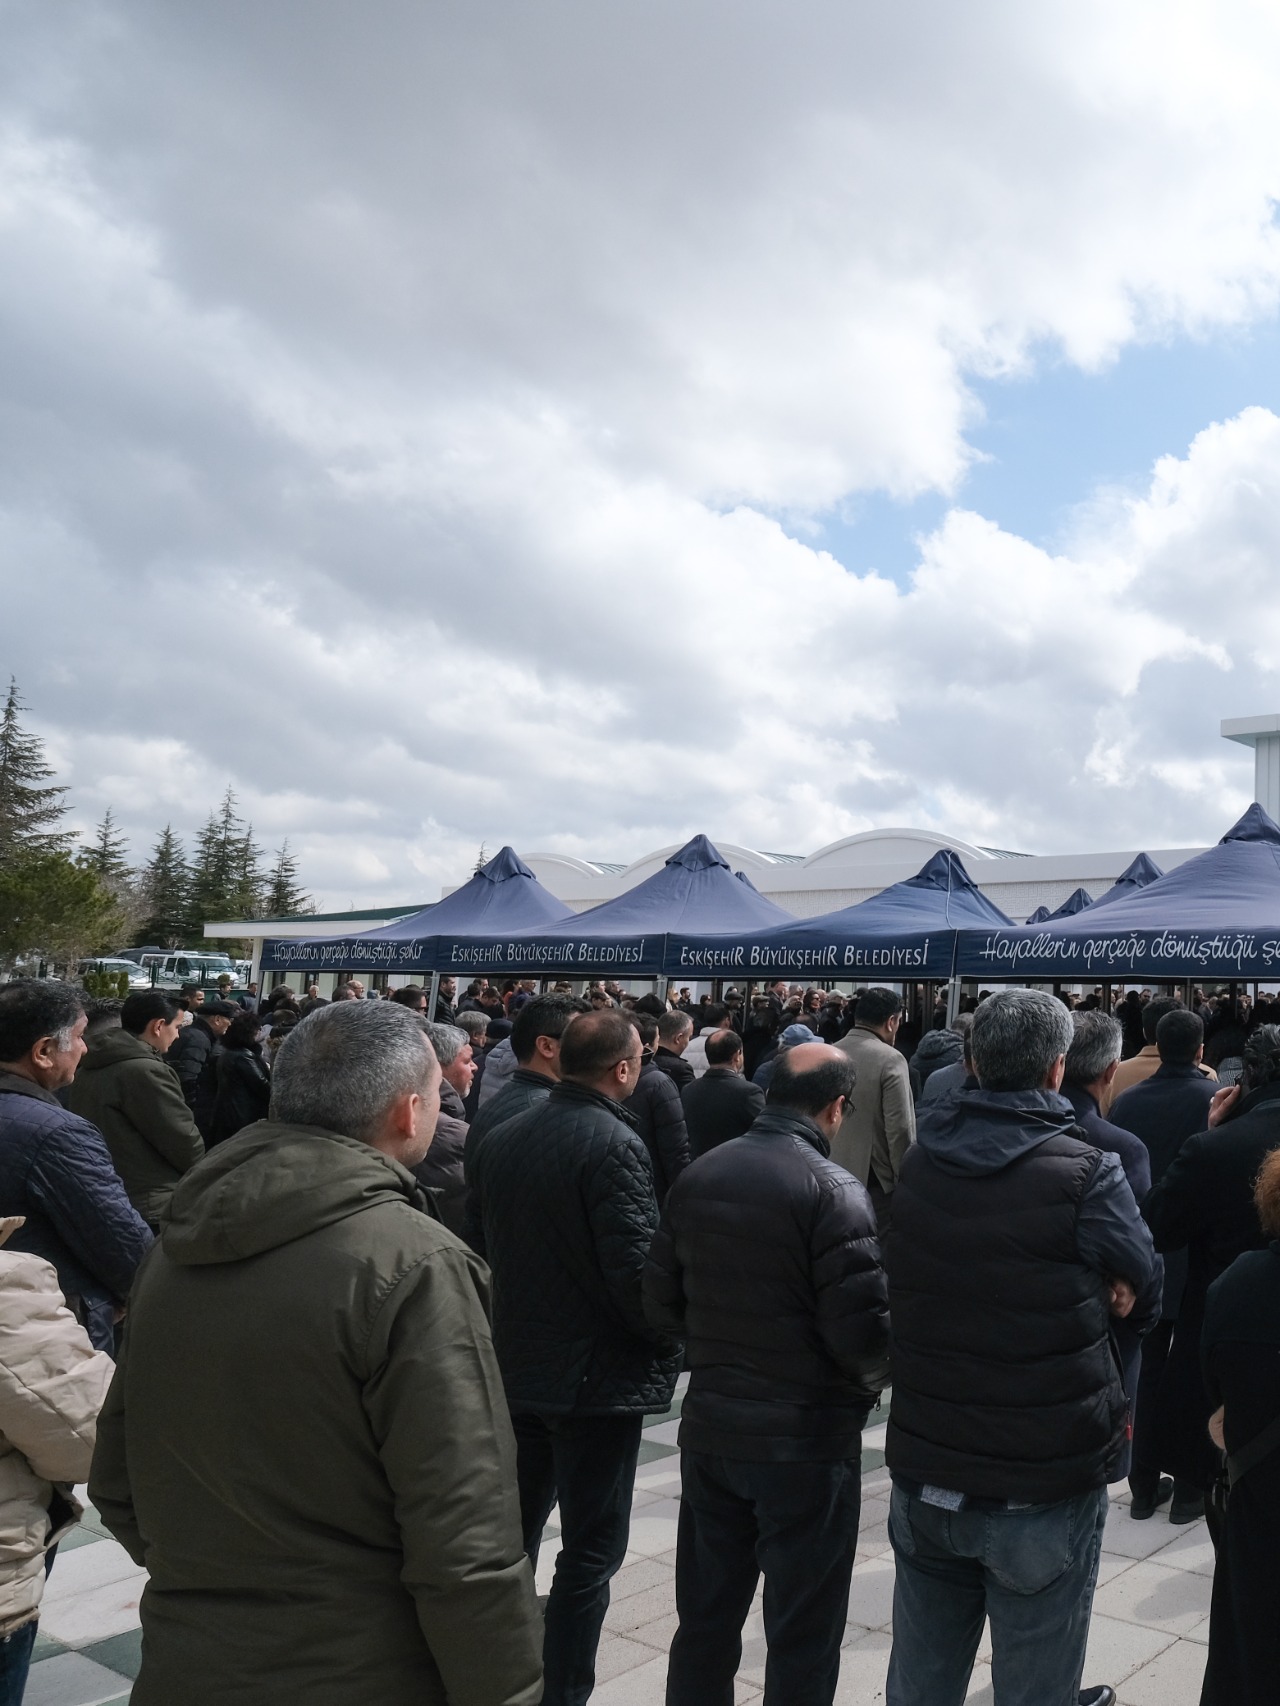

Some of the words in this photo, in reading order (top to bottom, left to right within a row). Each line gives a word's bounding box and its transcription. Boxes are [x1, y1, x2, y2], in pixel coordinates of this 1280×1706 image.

[272, 941, 318, 966] Hayallerin
[350, 939, 397, 966] dönüştüğü
[399, 939, 423, 963] şehir
[451, 944, 502, 965] ESKİŞEHİR
[507, 943, 574, 964] BÜYÜKŞEHİR
[578, 939, 645, 962] BELEDİYESİ
[680, 946, 745, 969] ESKİŞEHİR
[750, 945, 838, 969] BÜYÜKŞEHİR
[843, 938, 929, 966] BELEDİYESİ
[979, 931, 1080, 968] Hayallerin
[1082, 933, 1146, 969] gerçeğe
[1151, 930, 1257, 970] dönüştüğü
